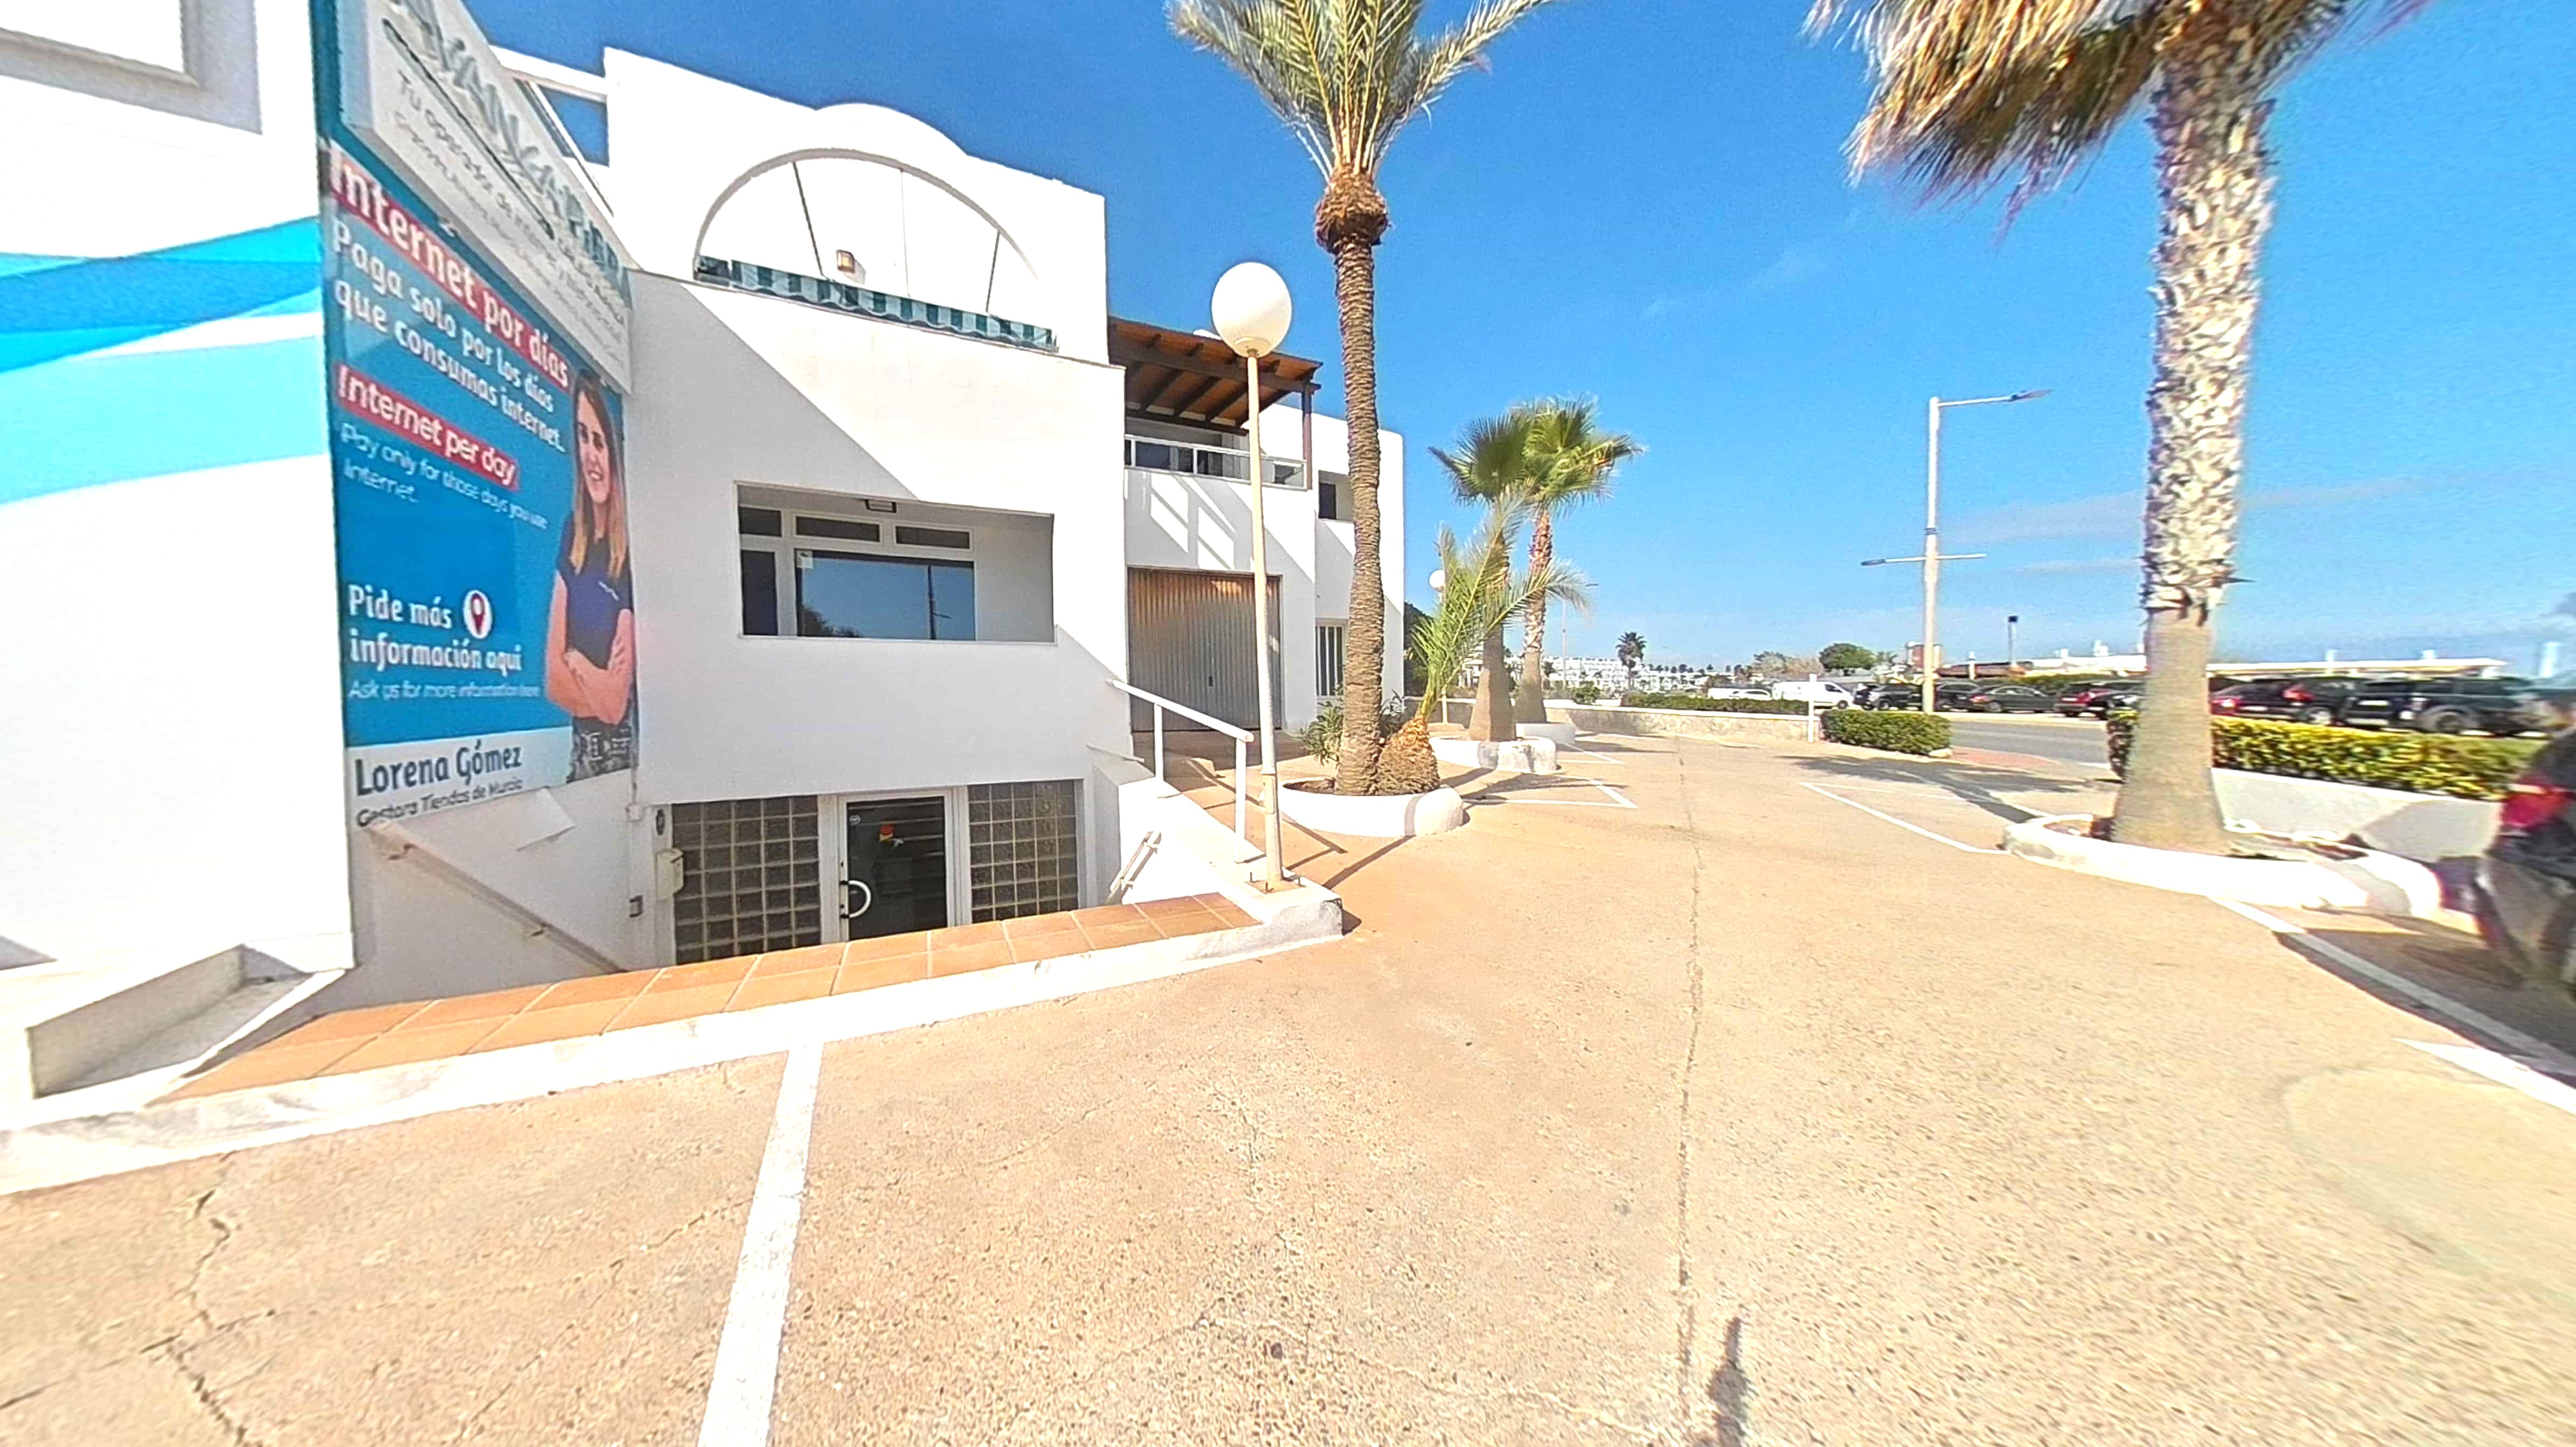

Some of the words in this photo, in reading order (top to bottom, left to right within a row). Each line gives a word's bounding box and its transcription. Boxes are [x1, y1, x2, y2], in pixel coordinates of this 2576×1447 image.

[330, 147, 477, 310] Internet
[482, 290, 524, 347] por
[333, 215, 404, 299] Paga
[409, 286, 457, 338] solo
[461, 327, 493, 366] por
[496, 346, 522, 388] los
[334, 279, 388, 333] que
[394, 320, 498, 406] consumas
[338, 364, 443, 446] Internet
[444, 430, 480, 463] per
[481, 447, 516, 486] day
[340, 423, 379, 459] Pay
[381, 446, 417, 475] only
[420, 458, 440, 480] for
[442, 470, 479, 500] those
[348, 584, 404, 622] Pide
[408, 595, 453, 629] más
[349, 627, 482, 672] información
[348, 679, 379, 698] Ask
[382, 684, 400, 700] us
[402, 679, 422, 698] for
[423, 684, 457, 698] more
[355, 756, 450, 796] Lorena
[457, 738, 522, 785] Gómez
[356, 801, 418, 828] Gestora
[420, 789, 470, 812] Tiendas
[472, 785, 486, 800] de
[489, 777, 523, 796] Murcia
